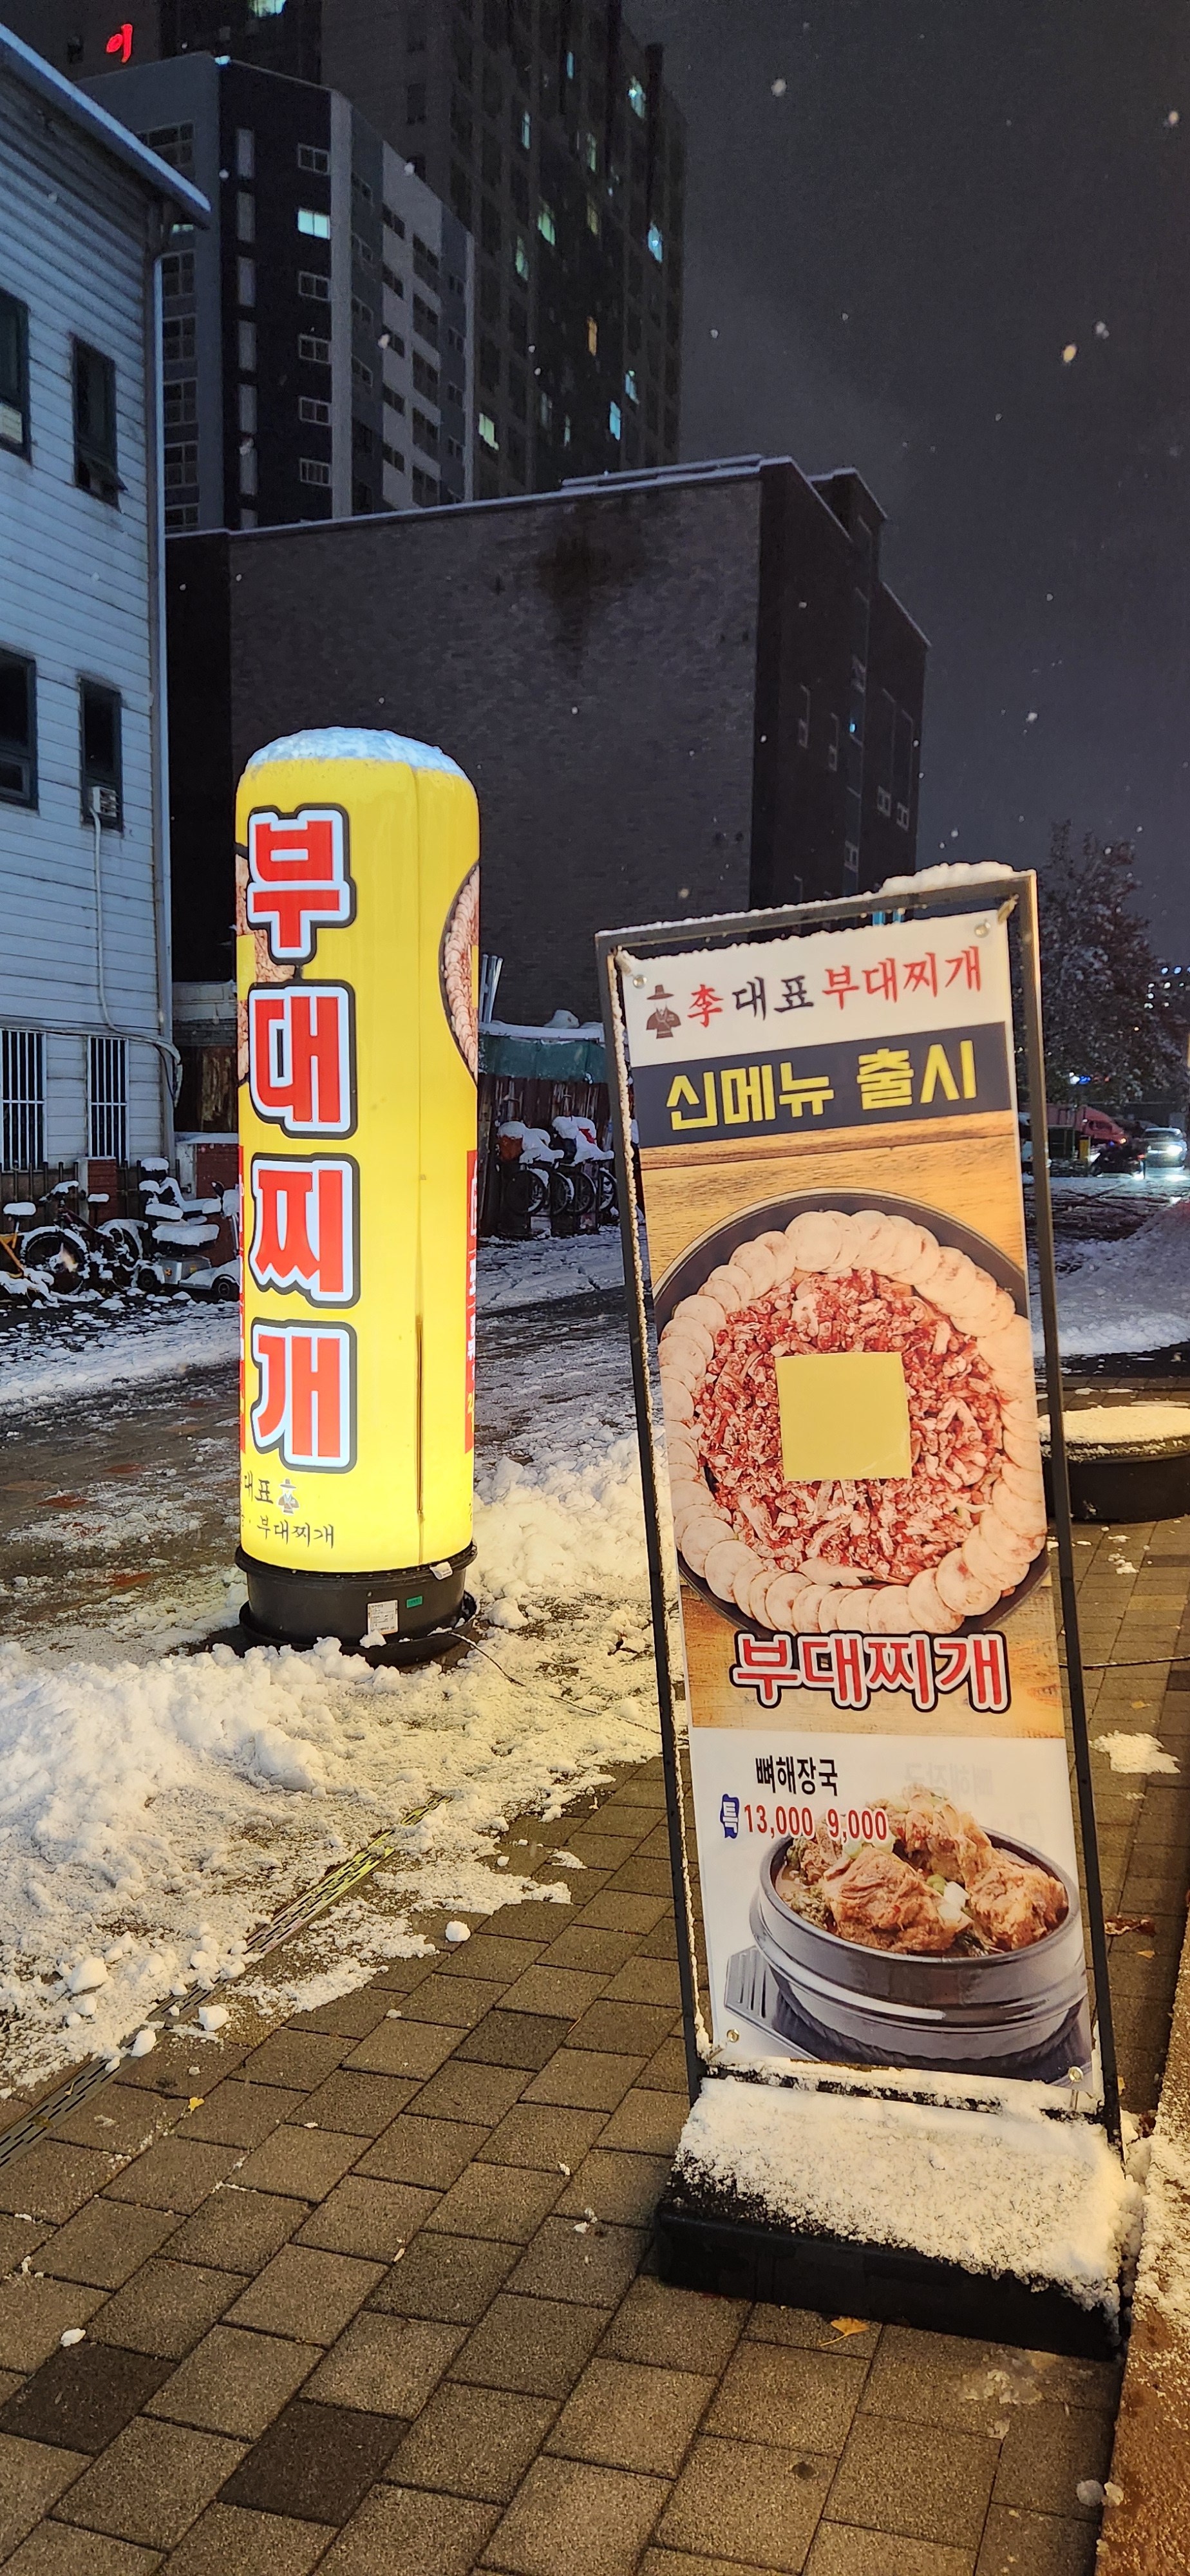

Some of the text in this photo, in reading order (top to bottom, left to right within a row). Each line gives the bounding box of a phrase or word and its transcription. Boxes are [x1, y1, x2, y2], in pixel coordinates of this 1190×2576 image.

[822, 945, 981, 1010] 부대찌개
[666, 1039, 977, 1132] 신메뉴 출시
[247, 803, 361, 1473] 부대찌개
[256, 1515, 334, 1549] 부대찌개
[730, 1630, 1012, 1714] 부대찌개
[755, 1755, 838, 1797] 뼈해장국
[721, 1799, 888, 1843] 특 13,000 9,000
